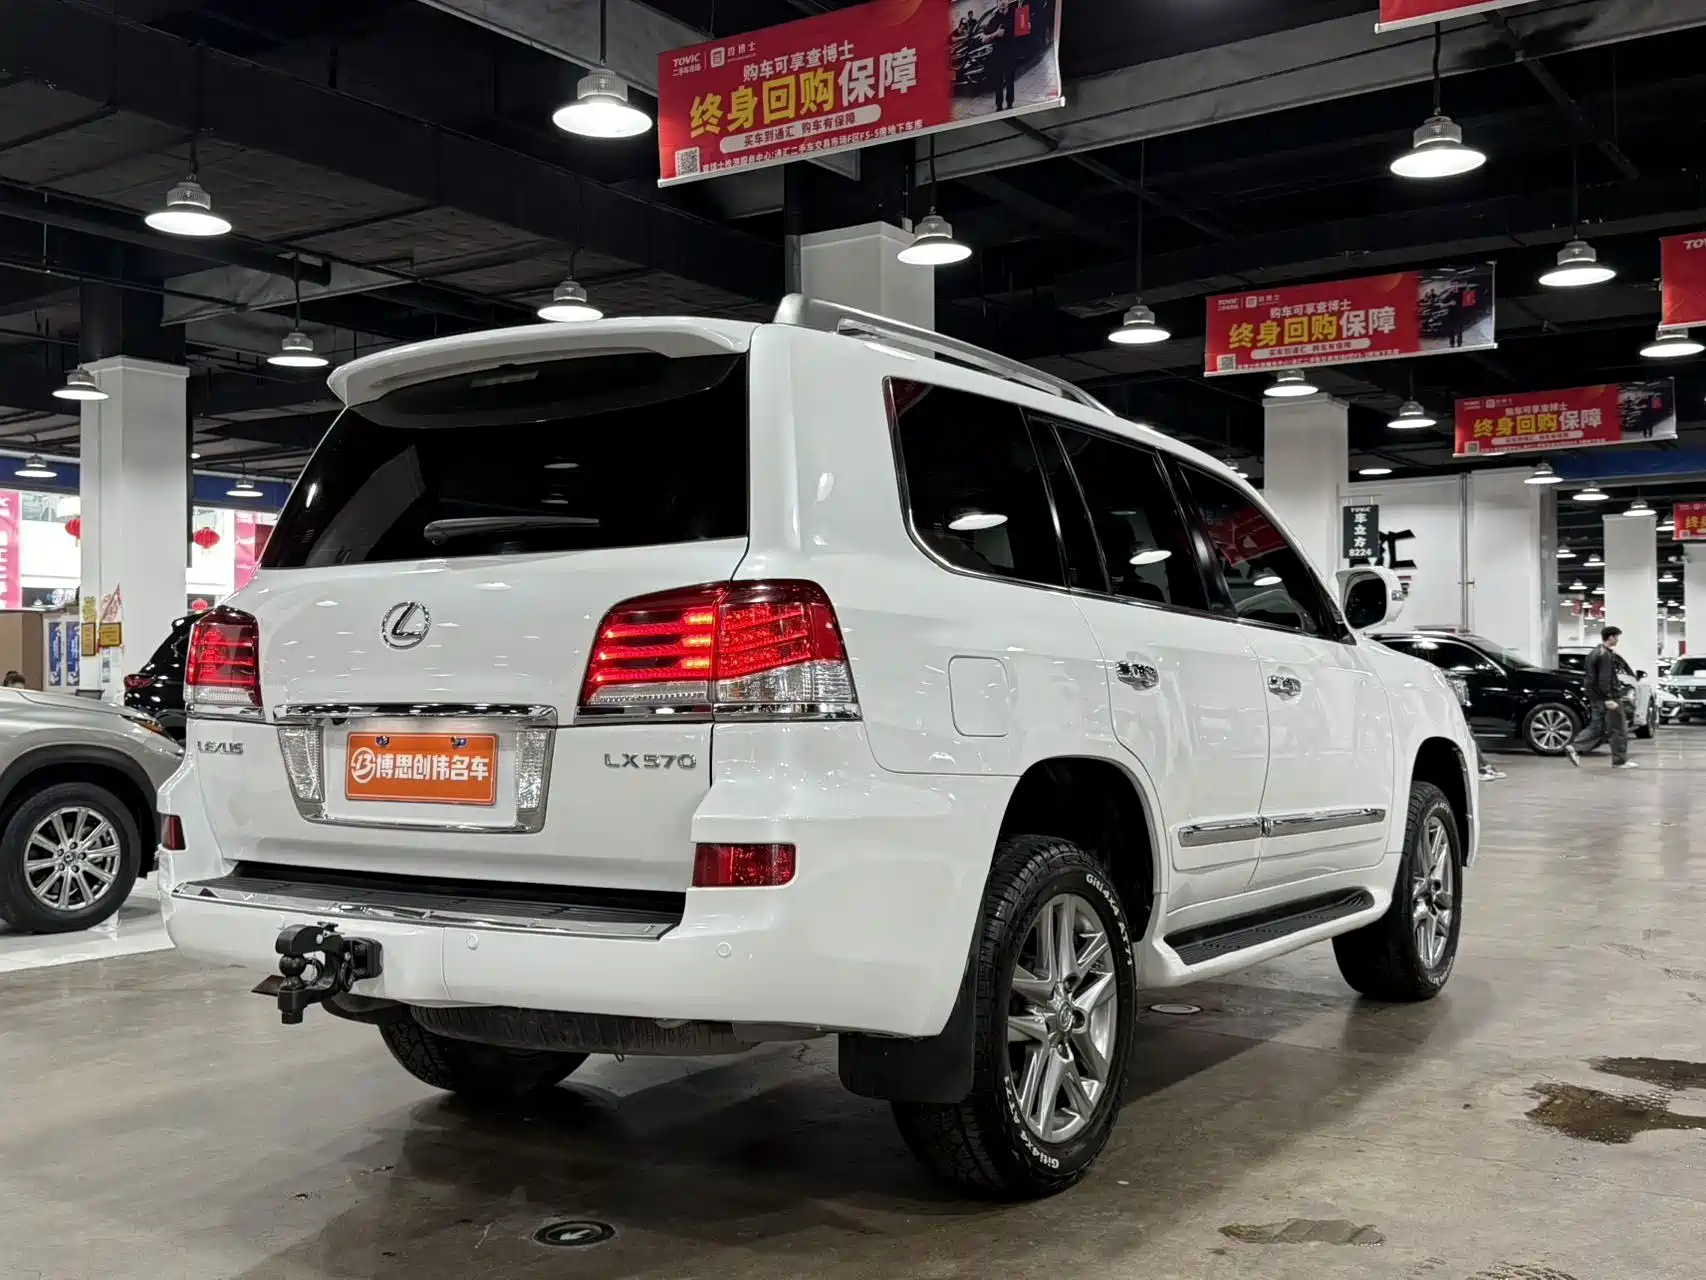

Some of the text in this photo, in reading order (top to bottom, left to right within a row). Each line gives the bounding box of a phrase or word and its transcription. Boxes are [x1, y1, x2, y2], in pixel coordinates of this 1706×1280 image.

[673, 53, 700, 68] TOVIC
[743, 40, 855, 83] 购车可享查博士
[689, 46, 917, 139] 终身回购保障
[744, 112, 856, 148] 买车到通汇 购车有保障
[1683, 238, 1706, 250] TO
[1270, 299, 1351, 319] 购车可享查博士
[1228, 306, 1396, 349] 终身回购保障
[1473, 408, 1602, 438] 终身回购保障
[1354, 513, 1368, 548] 车立方
